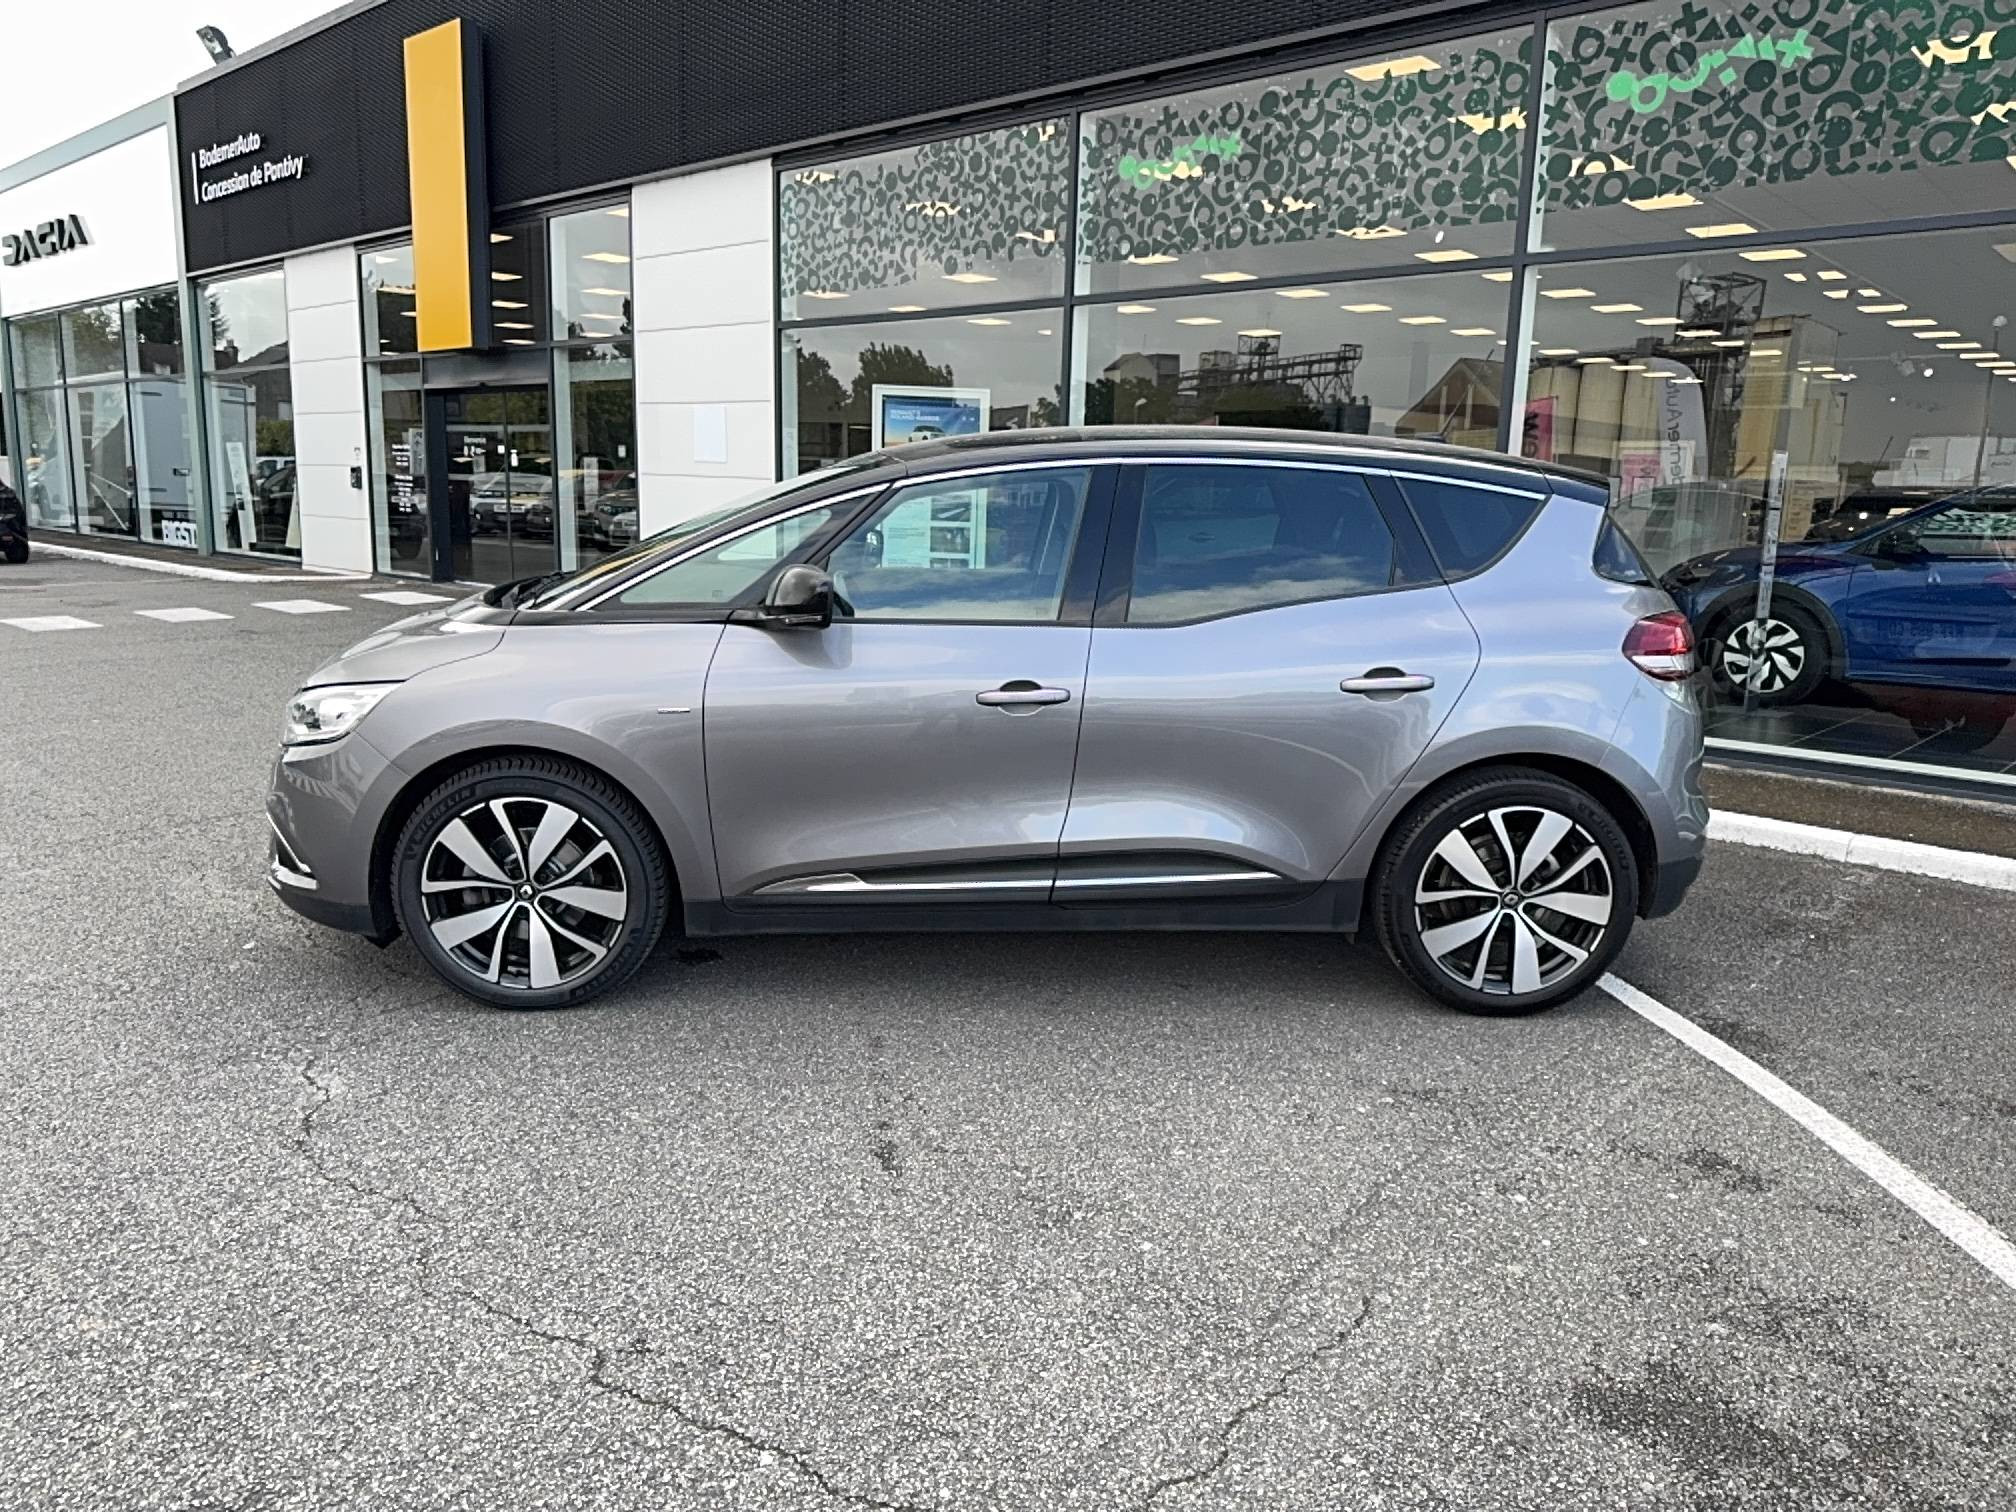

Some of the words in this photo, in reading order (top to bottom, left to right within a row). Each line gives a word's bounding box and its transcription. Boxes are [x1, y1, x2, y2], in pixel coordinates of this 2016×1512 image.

[199, 132, 260, 169] BodemerAuto
[202, 172, 250, 202] Concession
[250, 165, 263, 187] de
[263, 154, 303, 180] Pontivy
[1, 214, 88, 266] DACIA
